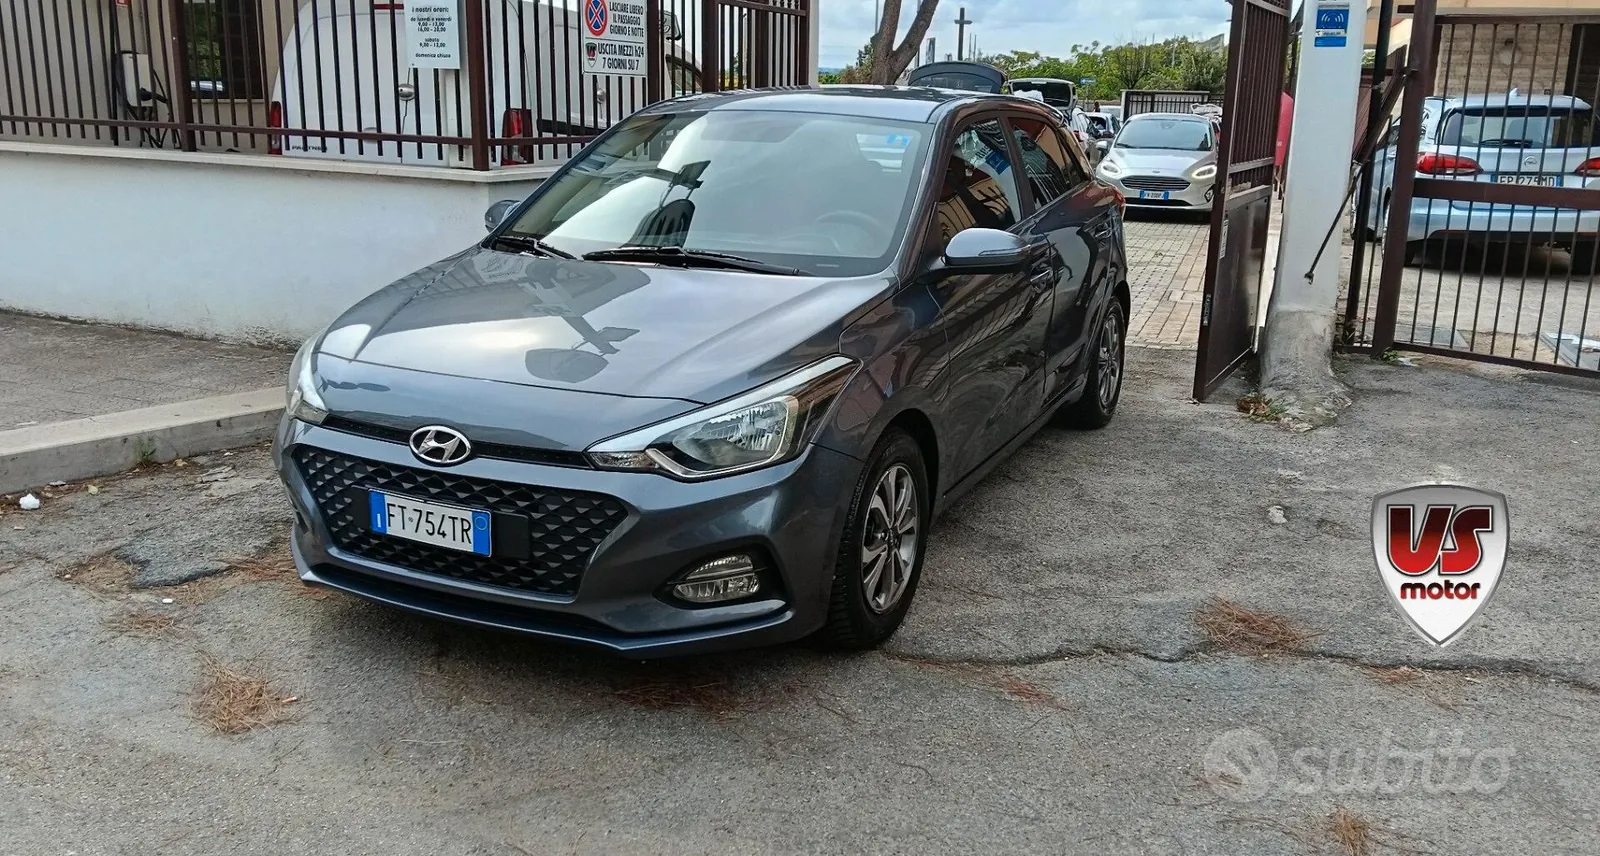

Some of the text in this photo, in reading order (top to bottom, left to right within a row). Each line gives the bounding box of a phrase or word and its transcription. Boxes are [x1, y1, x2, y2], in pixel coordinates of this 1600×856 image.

[609, 2, 644, 15] LASCIARE LIBERO
[613, 13, 641, 26] IL PASSAGGIO
[610, 24, 644, 37] GIORNO E NOTTE
[598, 43, 644, 57] USCITA MEZZI h24
[602, 57, 606, 68] 7
[607, 57, 627, 69] GIORNI
[628, 59, 635, 70] SU
